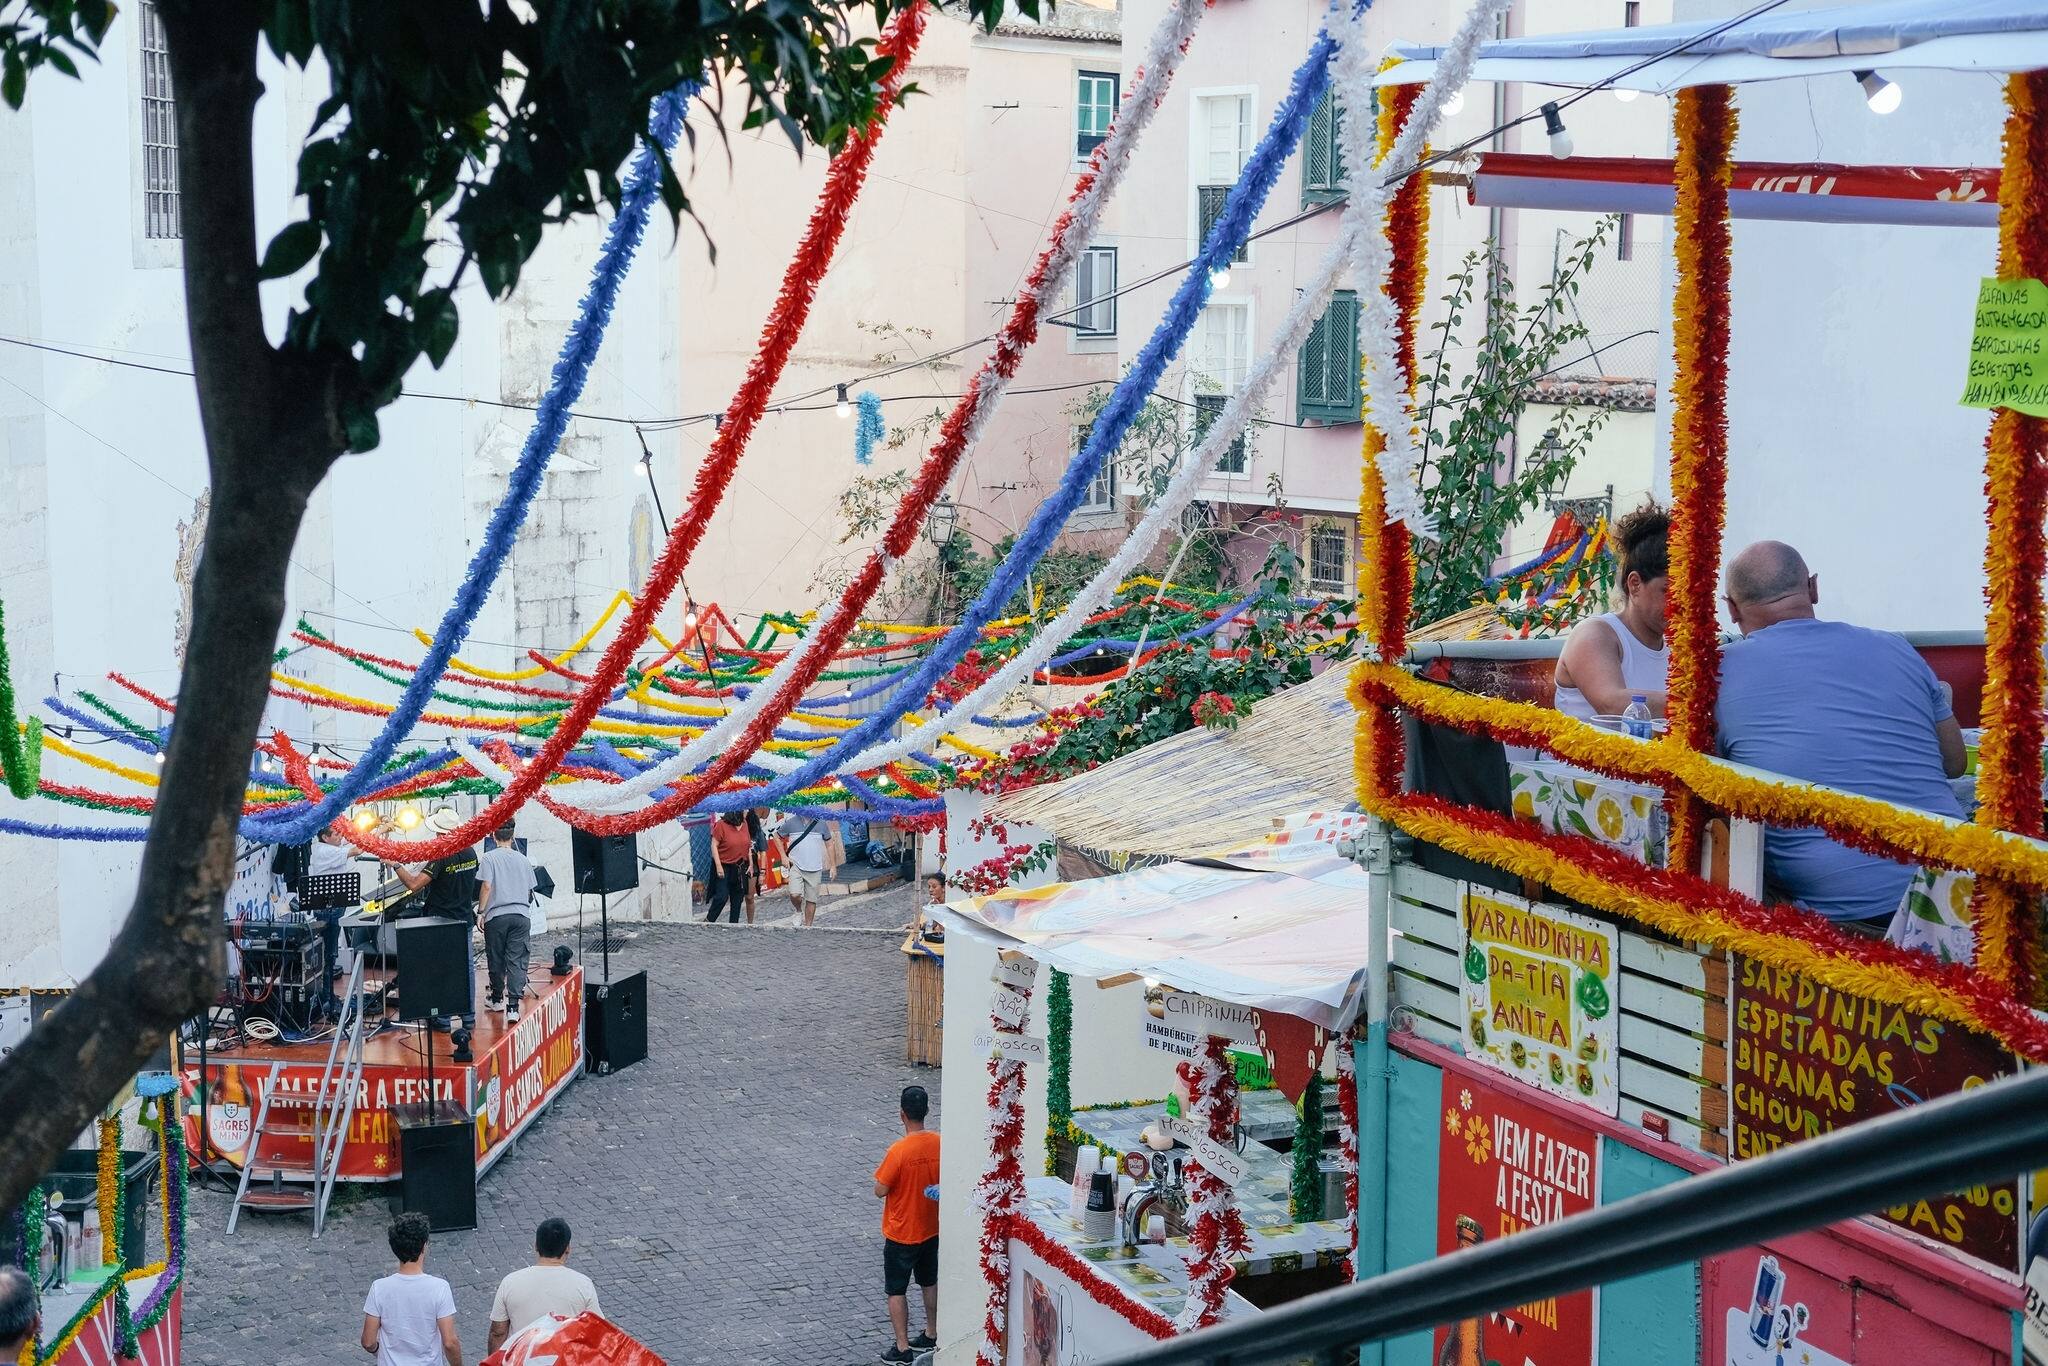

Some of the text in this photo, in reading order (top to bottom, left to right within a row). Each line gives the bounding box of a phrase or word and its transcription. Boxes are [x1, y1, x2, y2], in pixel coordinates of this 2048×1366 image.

[545, 985, 567, 1038] TODOS
[1492, 1000, 1568, 1047] ANITA
[1741, 957, 1945, 1054] SARDINHAS
[1149, 1038, 1195, 1058] DE PICANH
[1737, 998, 1894, 1086] ESPETADAS
[376, 1079, 388, 1112] A
[505, 1085, 515, 1130] OS
[516, 1056, 543, 1119] SANTOS
[1735, 1037, 1856, 1113] BIFANAS
[213, 1119, 248, 1132] SAGRES
[1494, 1114, 1590, 1200] VEM FAZER
[1496, 1164, 1564, 1226] A FESTA
